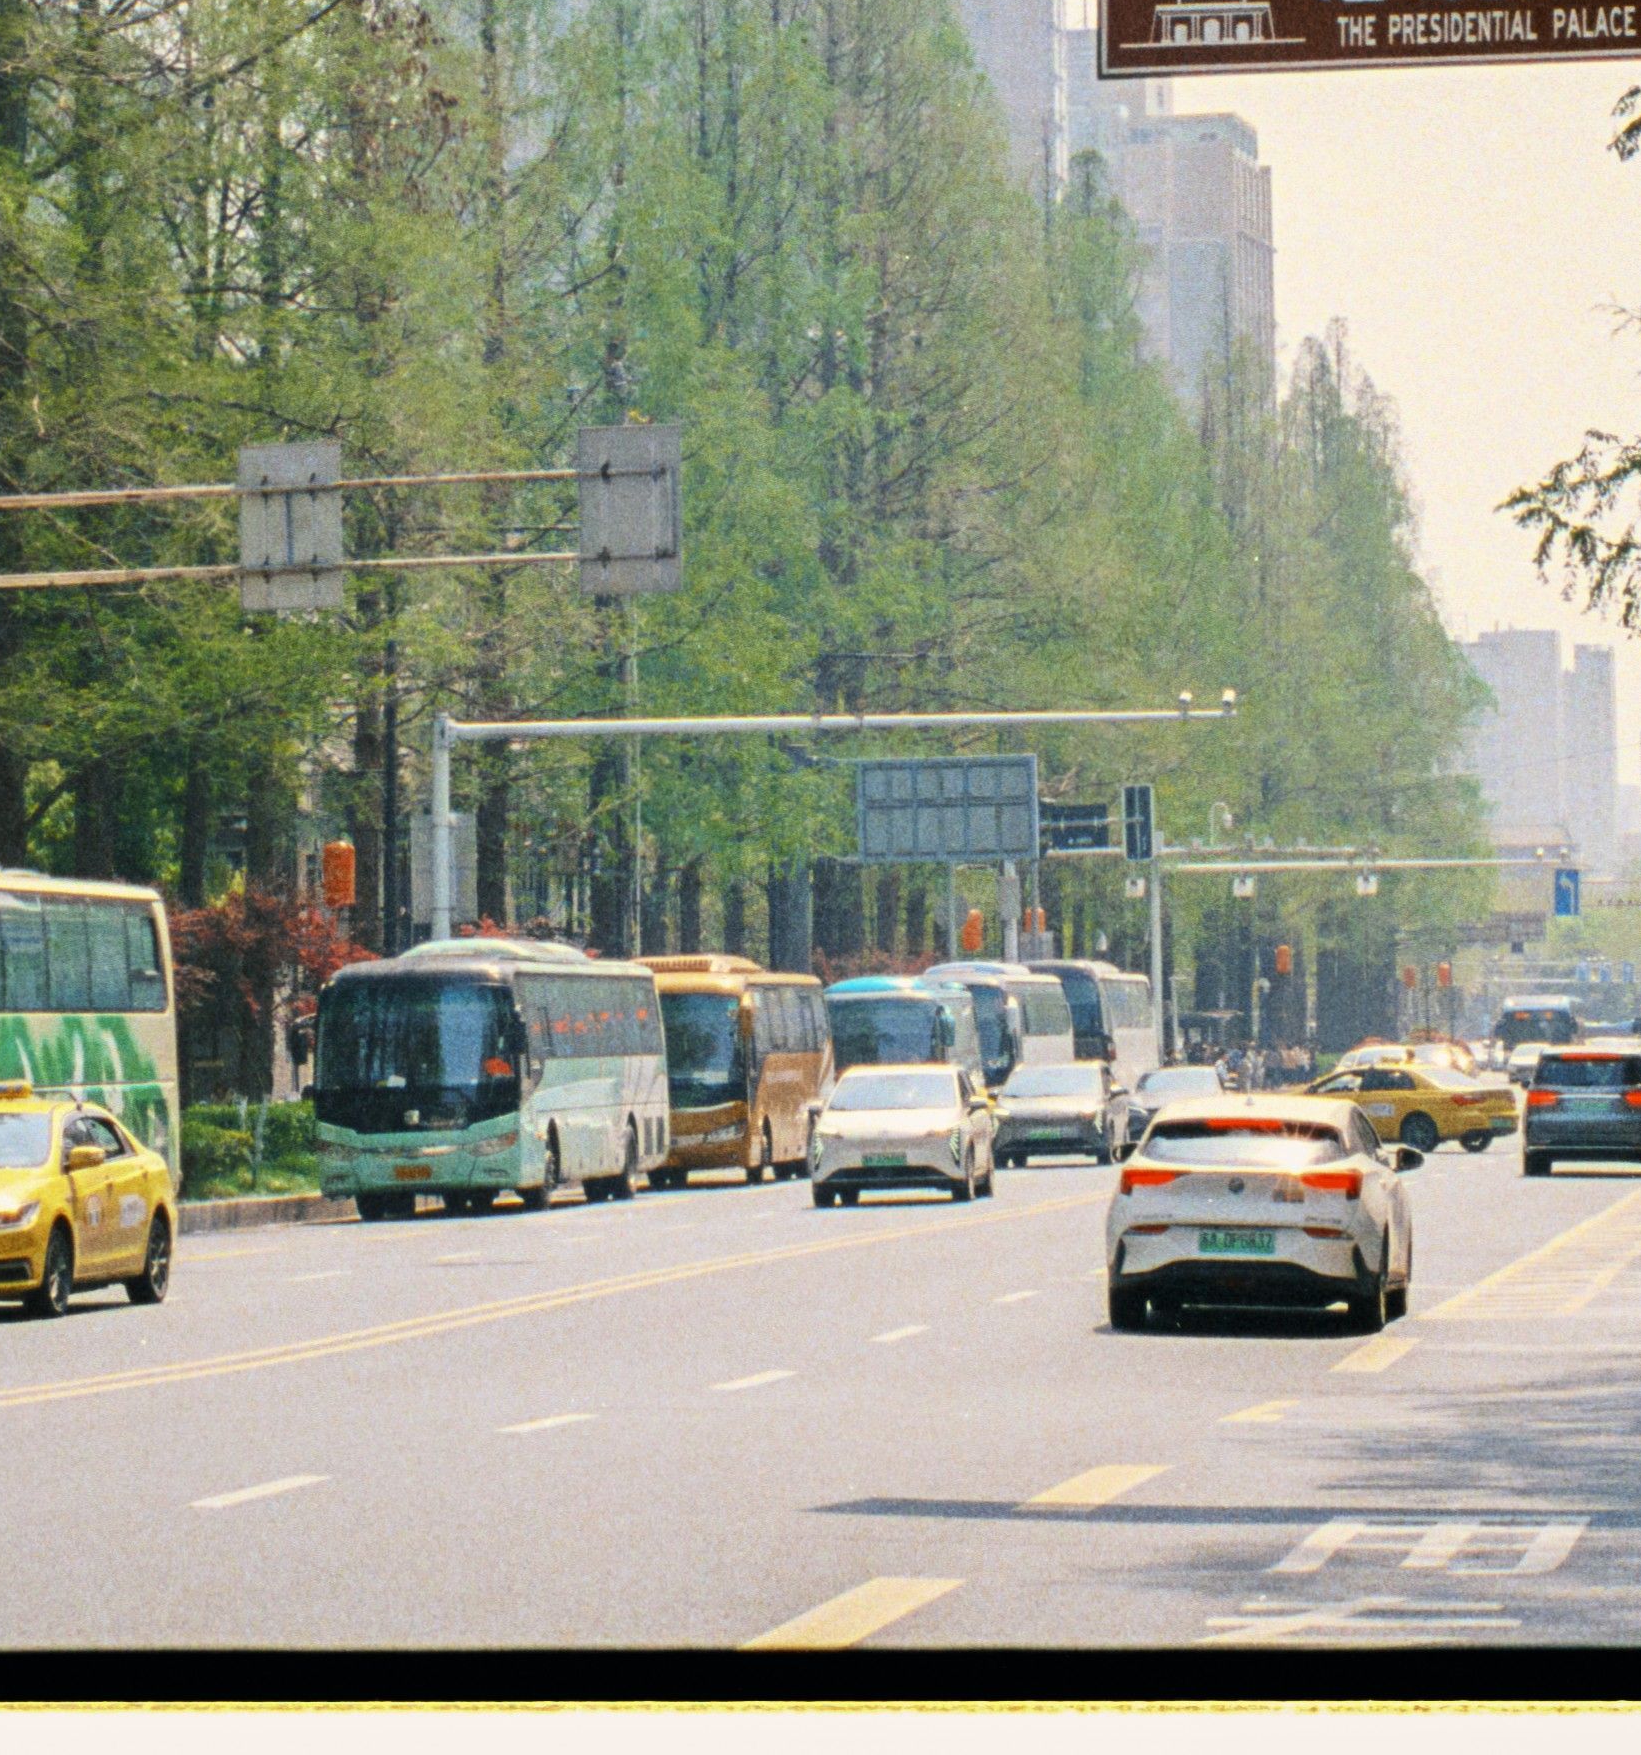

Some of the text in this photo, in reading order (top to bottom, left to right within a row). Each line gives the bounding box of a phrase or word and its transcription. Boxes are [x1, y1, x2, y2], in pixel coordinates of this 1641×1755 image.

[1337, 14, 1377, 47] THE
[1389, 9, 1538, 46] PRESIDENTIAL
[1552, 5, 1637, 40] PALACE
